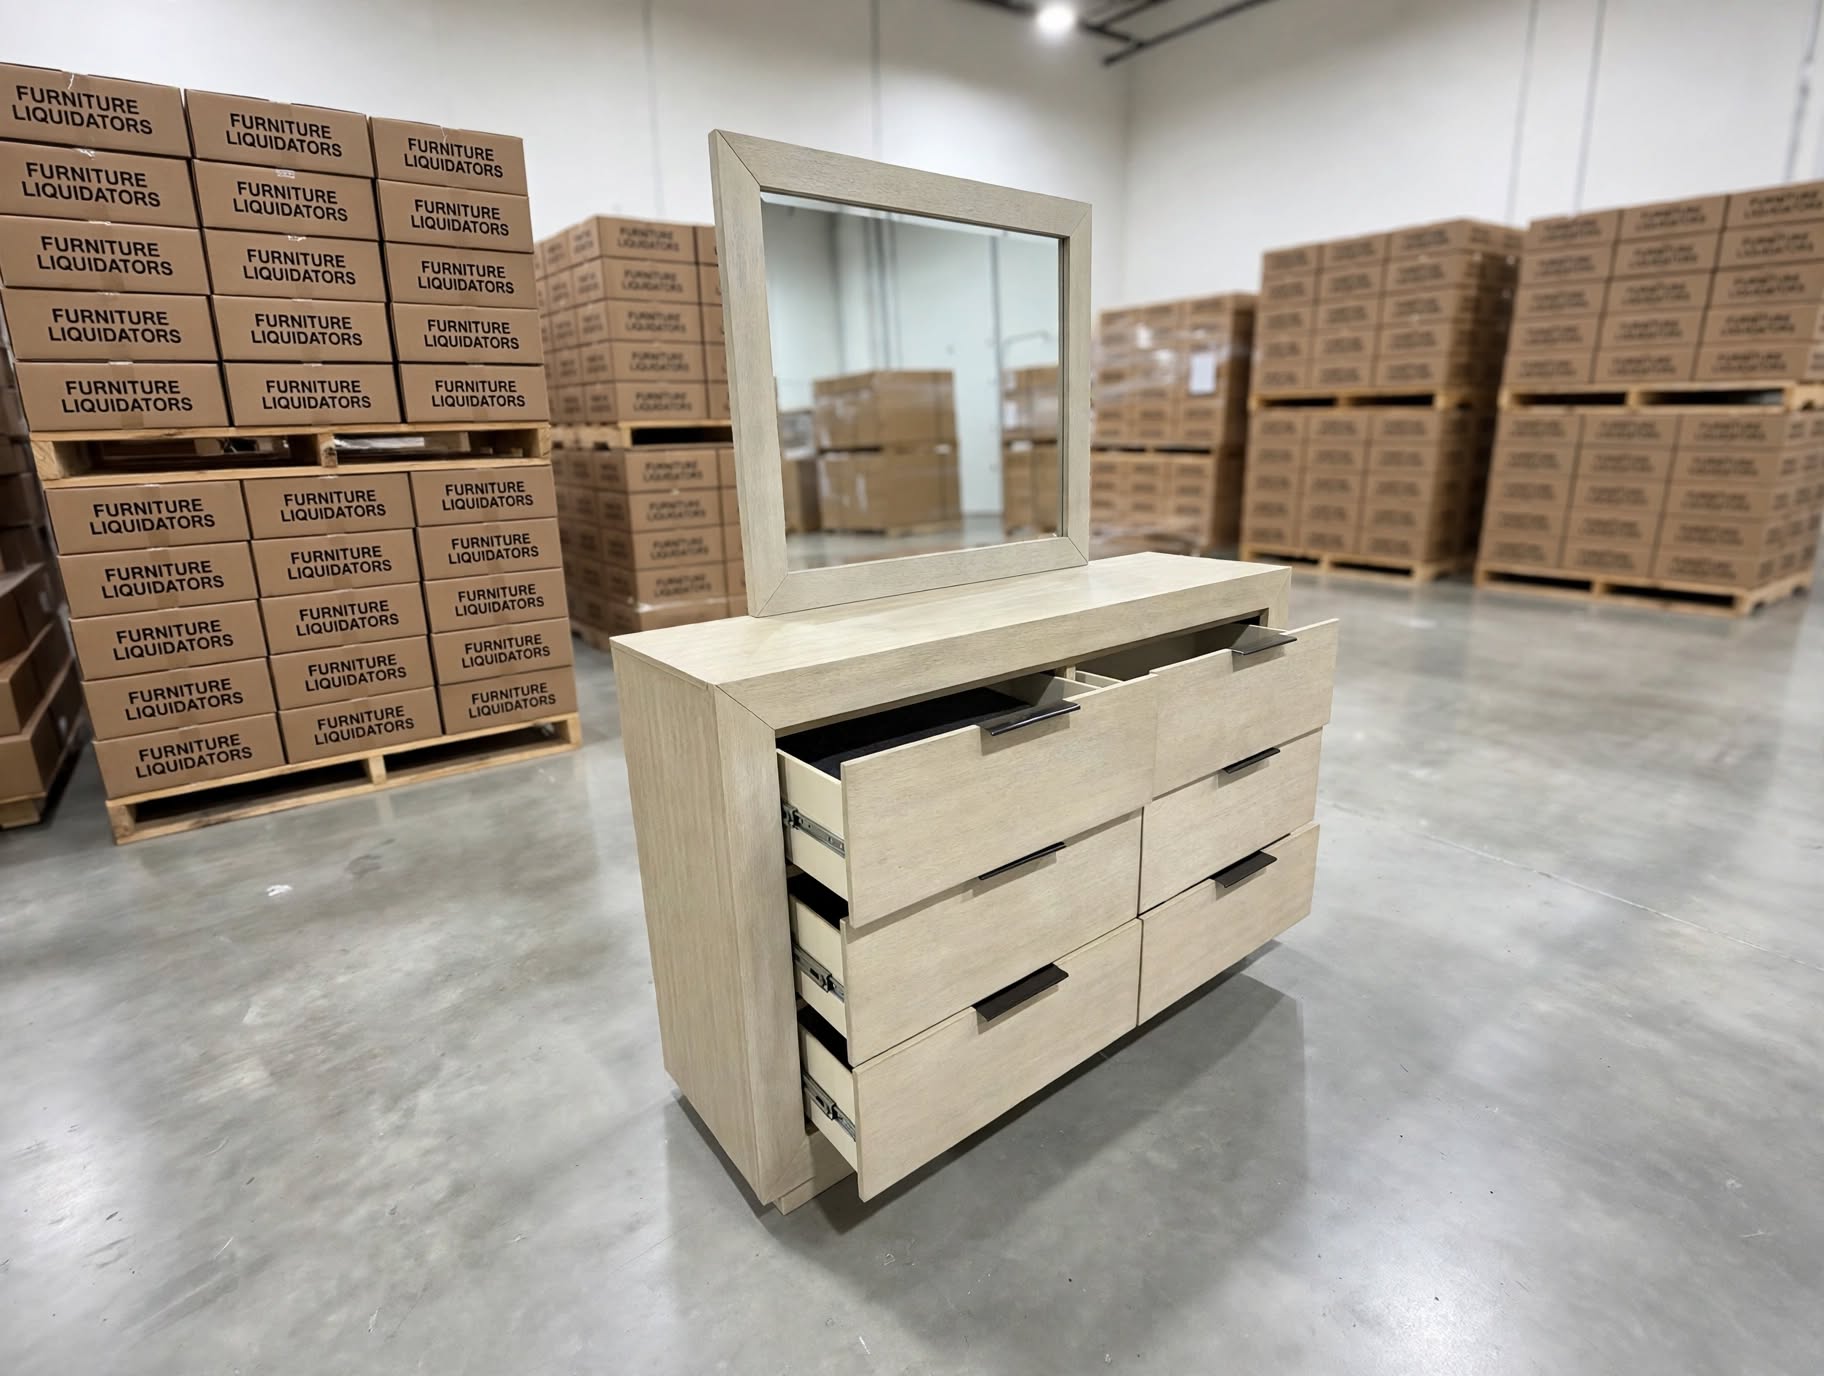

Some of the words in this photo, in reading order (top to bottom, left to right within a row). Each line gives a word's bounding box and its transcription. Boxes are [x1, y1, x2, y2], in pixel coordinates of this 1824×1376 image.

[16, 86, 139, 114] FURNITURE
[12, 105, 152, 134] LIQUIDATORS
[230, 113, 332, 139] FURNITURE
[226, 130, 342, 157] LIQUIDATORS
[408, 138, 494, 161] FURNITURE
[26, 162, 147, 188] FURNITURE
[404, 154, 503, 178] LIQUIDATORS
[22, 181, 160, 207] LIQUIDATORS
[238, 181, 337, 204] FURNITURE
[233, 198, 348, 221] LIQUIDATORS
[415, 200, 500, 220] FURNITURE
[411, 215, 508, 236] LIQUIDATORS
[41, 236, 160, 257] FURNITURE
[37, 254, 172, 275] LIQUIDATORS
[247, 249, 346, 268] FURNITURE
[243, 266, 356, 284] LIQUIDATORS
[422, 261, 506, 278] FURNITURE
[418, 276, 514, 294] LIQUIDATORS
[52, 308, 168, 325] FURNITURE
[255, 314, 352, 329] FURNITURE
[48, 327, 181, 343] LIQUIDATORS
[428, 320, 510, 334] FURNITURE
[251, 330, 362, 346] LIQUIDATORS
[424, 335, 519, 349] LIQUIDATORS
[66, 381, 180, 395] FURNITURE
[266, 380, 361, 393] FURNITURE
[436, 380, 516, 392] FURNITURE
[62, 398, 192, 412] LIQUIDATORS
[262, 396, 371, 409] LIQUIDATORS
[432, 395, 525, 407] LIQUIDATORS
[284, 490, 376, 506] FURNITURE
[446, 481, 525, 496] FURNITURE
[94, 499, 203, 517] FURNITURE
[442, 495, 533, 510] LIQUIDATORS
[281, 504, 386, 522] LIQUIDATORS
[90, 514, 215, 534] LIQUIDATORS
[452, 534, 530, 550] FURNITURE
[291, 546, 382, 564] FURNITURE
[448, 546, 538, 564] LIQUIDATORS
[105, 561, 212, 582] FURNITURE
[288, 560, 392, 580] LIQUIDATORS
[102, 576, 224, 598] LIQUIDATORS
[458, 584, 536, 602] FURNITURE
[300, 600, 389, 621] FURNITURE
[455, 596, 544, 616] LIQUIDATORS
[116, 620, 222, 644] FURNITURE
[296, 614, 399, 636] LIQUIDATORS
[113, 634, 233, 660] LIQUIDATORS
[465, 634, 542, 654] FURNITURE
[308, 654, 396, 676] FURNITURE
[462, 646, 550, 668] LIQUIDATORS
[305, 667, 406, 691] LIQUIDATORS
[128, 678, 232, 704] FURNITURE
[472, 683, 547, 704] FURNITURE
[125, 692, 243, 721] LIQUIDATORS
[469, 694, 556, 718] LIQUIDATORS
[318, 706, 404, 730] FURNITURE
[314, 718, 414, 745] LIQUIDATORS
[139, 734, 240, 762] FURNITURE
[136, 747, 252, 778] LIQUIDATORS
